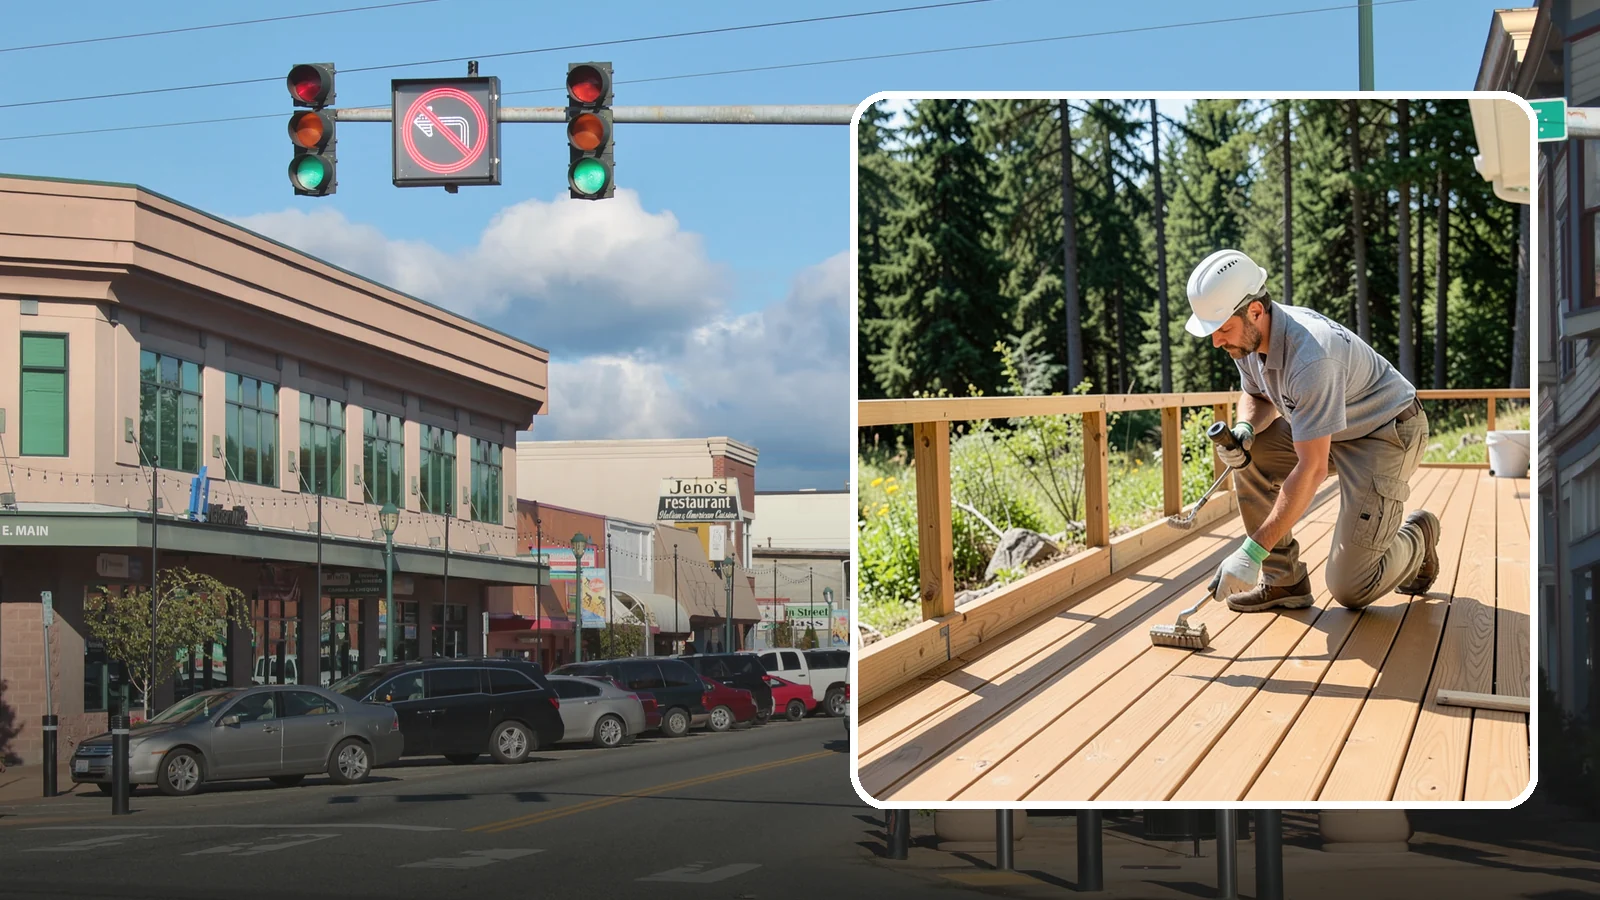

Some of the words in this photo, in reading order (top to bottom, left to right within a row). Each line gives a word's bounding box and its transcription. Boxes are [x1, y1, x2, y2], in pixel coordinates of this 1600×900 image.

[670, 480, 727, 494] Jeno's
[665, 496, 731, 509] restaurant
[659, 510, 681, 519] Italian
[686, 510, 714, 519] American
[715, 509, 737, 519] Cuisine
[2, 525, 13, 536] E.
[15, 525, 49, 536] MAIN
[797, 608, 828, 617] Street
[791, 619, 823, 627] lass
